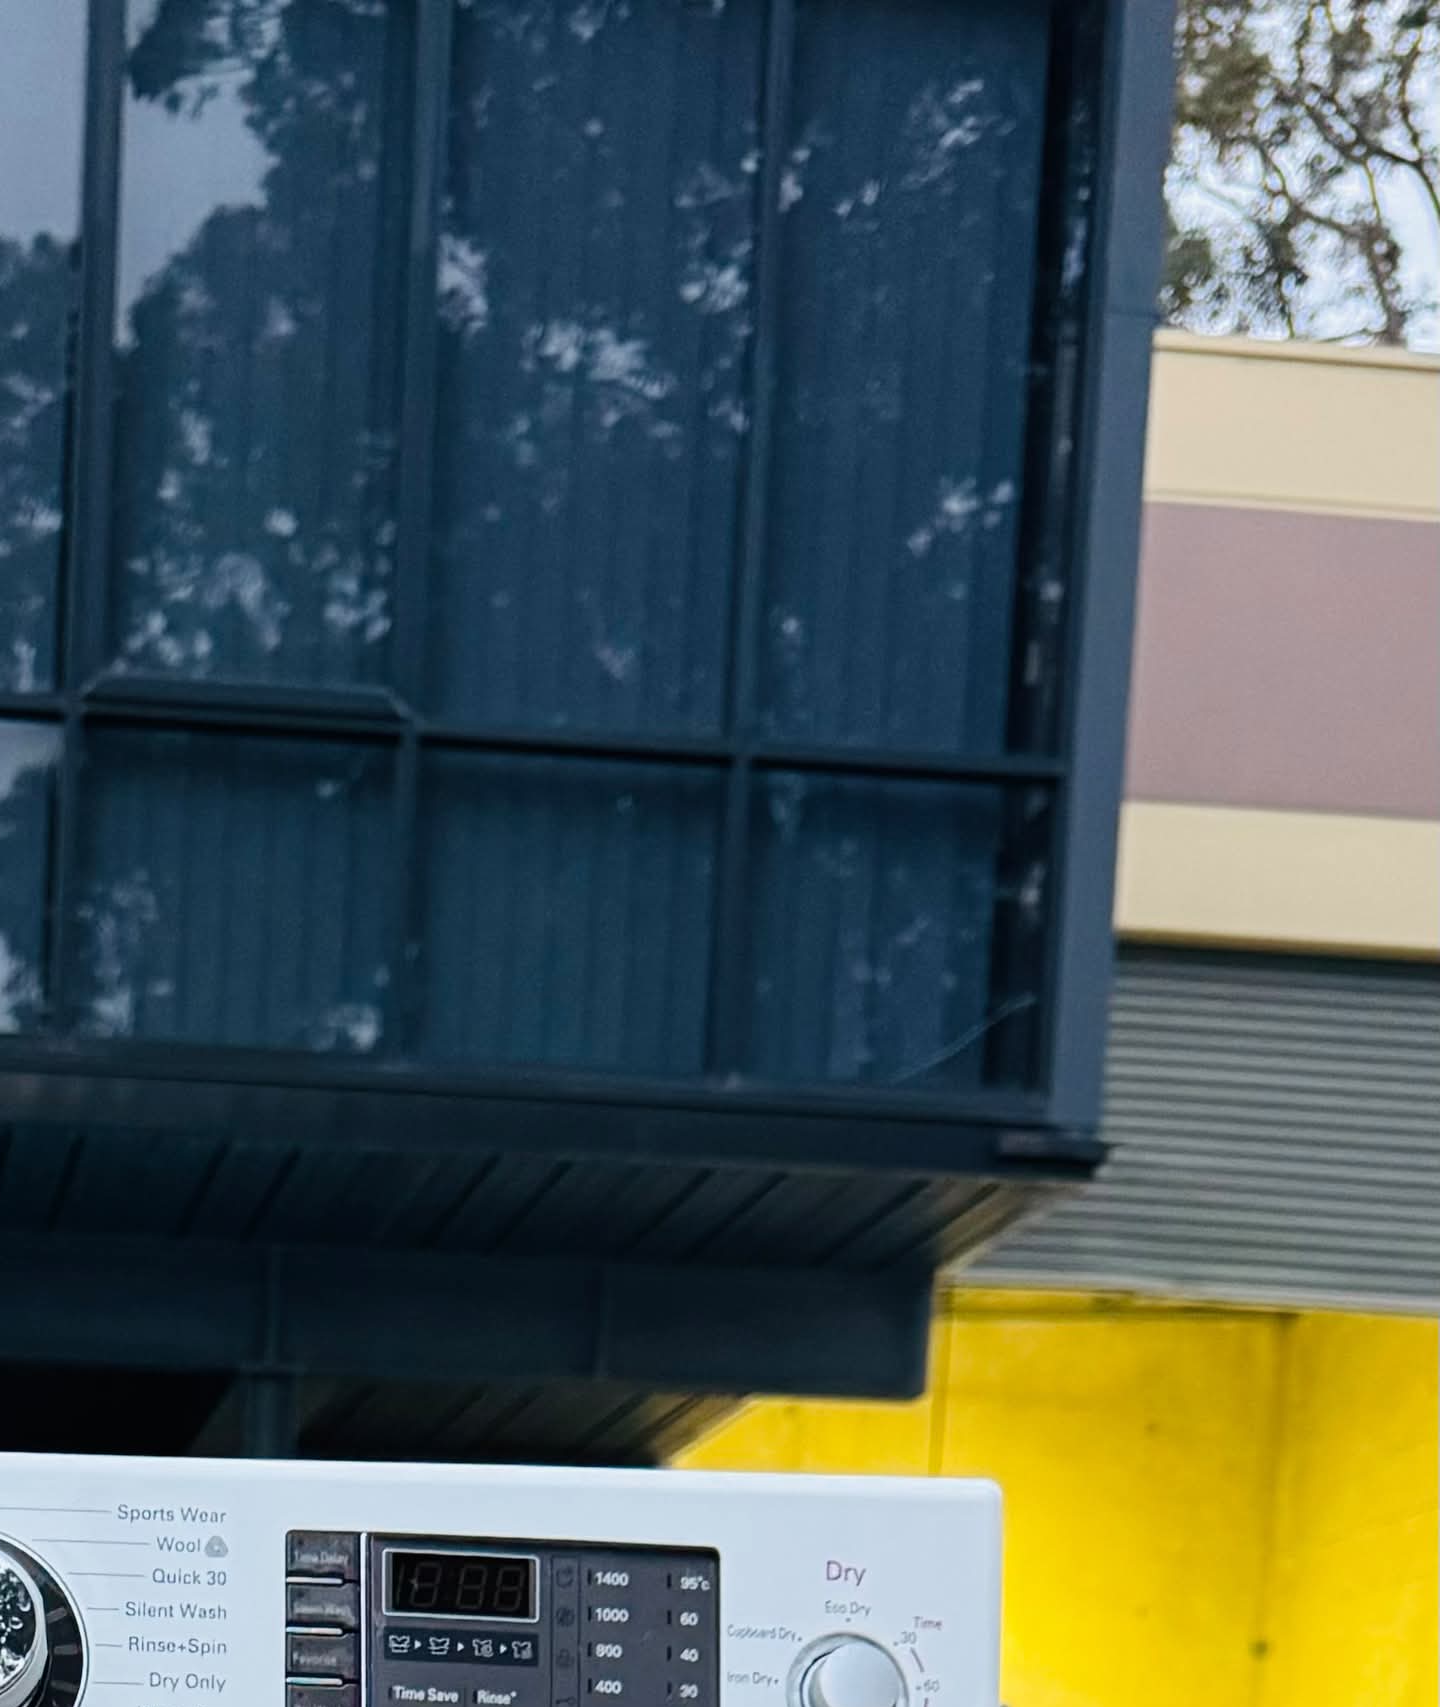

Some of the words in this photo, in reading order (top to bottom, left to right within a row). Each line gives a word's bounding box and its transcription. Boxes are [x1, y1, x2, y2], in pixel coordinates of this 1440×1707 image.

[117, 1503, 175, 1524] Sports
[180, 1506, 227, 1523] Wear
[156, 1536, 201, 1552] Wool
[152, 1568, 201, 1584] Quick
[206, 1571, 227, 1586] 30
[595, 1571, 629, 1587] 1400
[826, 1560, 866, 1586] Dry
[125, 1601, 175, 1618] Silent
[180, 1603, 227, 1620] Wash
[595, 1607, 629, 1623] 1000
[825, 1600, 846, 1614] Eco
[849, 1602, 871, 1616] Dry
[680, 1611, 699, 1626] 60
[913, 1616, 943, 1630] Time
[128, 1636, 227, 1656] Rinse+Spin
[595, 1643, 623, 1658] 800
[680, 1648, 699, 1662] 40
[149, 1672, 180, 1692] Dry
[185, 1673, 227, 1693] Only
[595, 1679, 622, 1694] 400
[752, 1672, 773, 1686] Dry
[923, 1679, 940, 1692] 60
[392, 1685, 425, 1701] Time
[427, 1687, 458, 1703] Save
